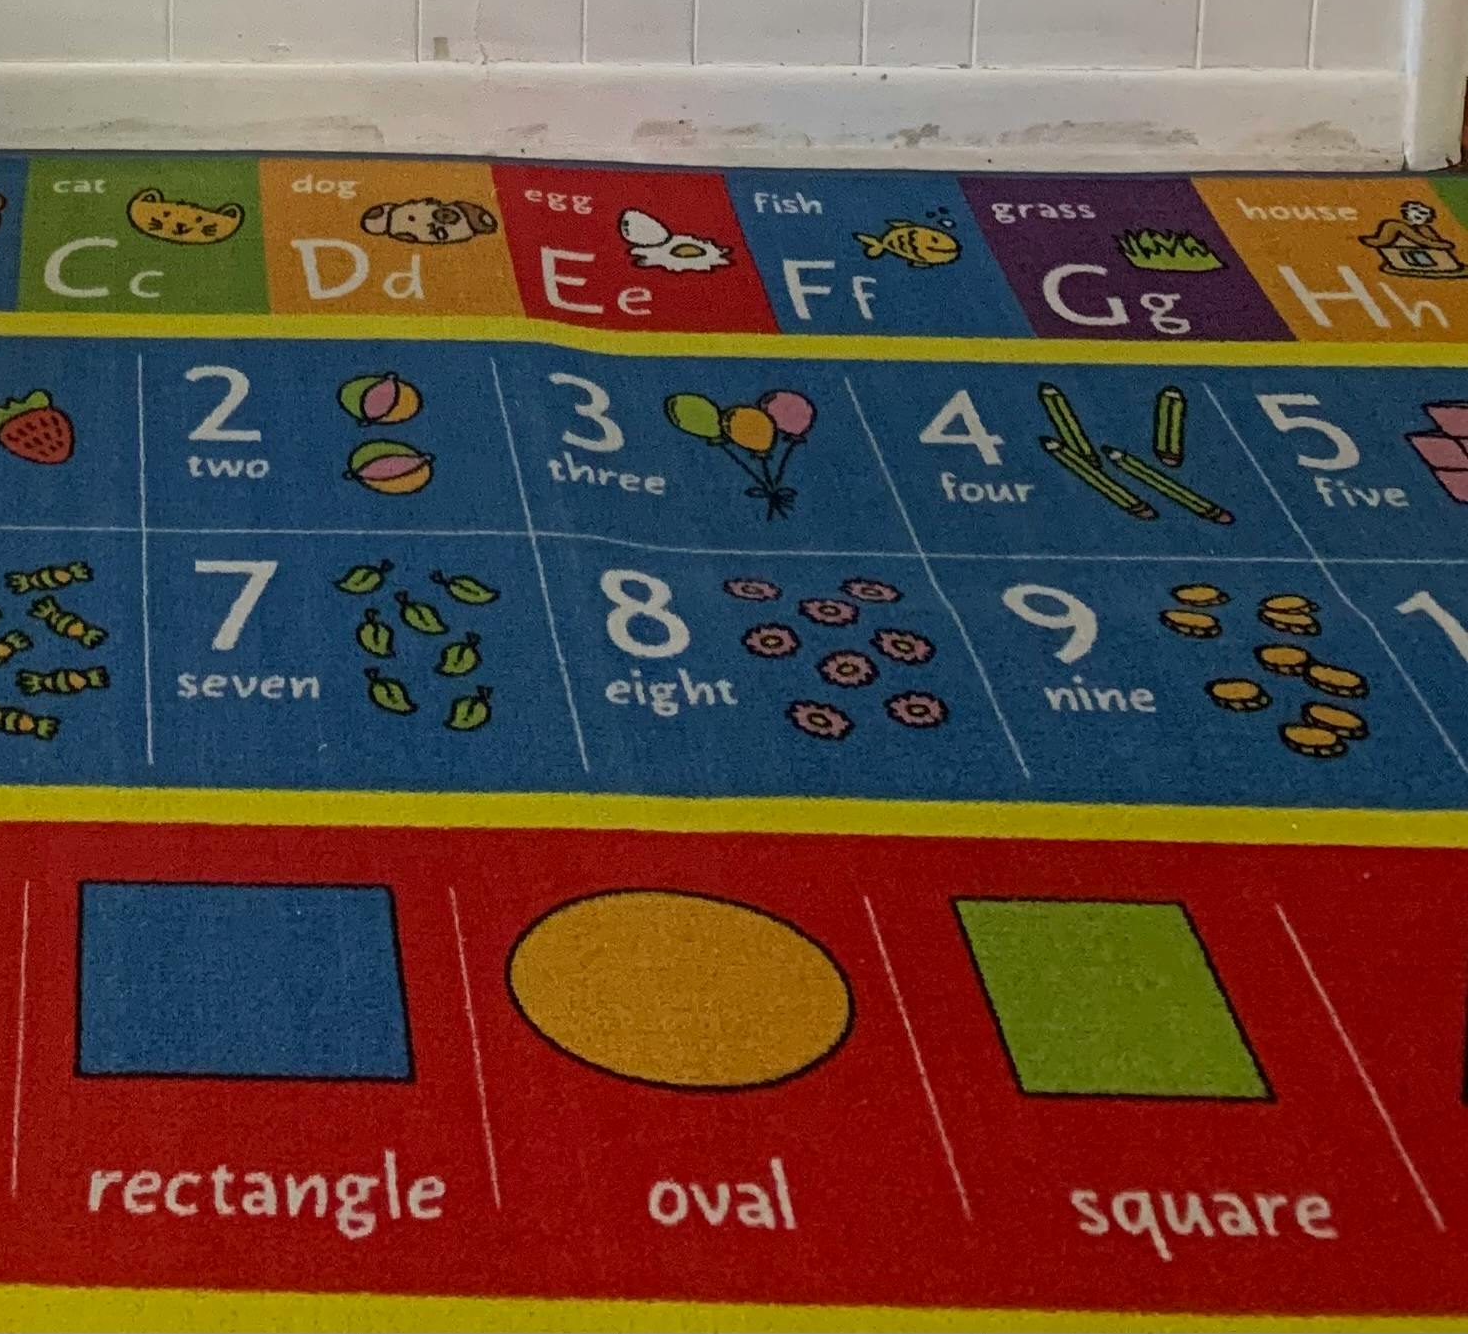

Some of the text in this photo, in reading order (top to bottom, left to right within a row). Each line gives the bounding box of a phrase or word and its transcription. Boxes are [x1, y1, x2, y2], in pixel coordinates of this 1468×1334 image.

[524, 186, 594, 216] egg
[990, 199, 1097, 226] grass
[1236, 199, 1358, 223] house
[549, 455, 667, 496] three
[1312, 475, 1410, 511] five
[178, 671, 321, 703] seven
[605, 673, 737, 716] eight
[1044, 674, 1155, 713] nine
[87, 1149, 448, 1239] rectangle
[647, 1159, 795, 1232] oval
[1072, 1185, 1337, 1259] square
